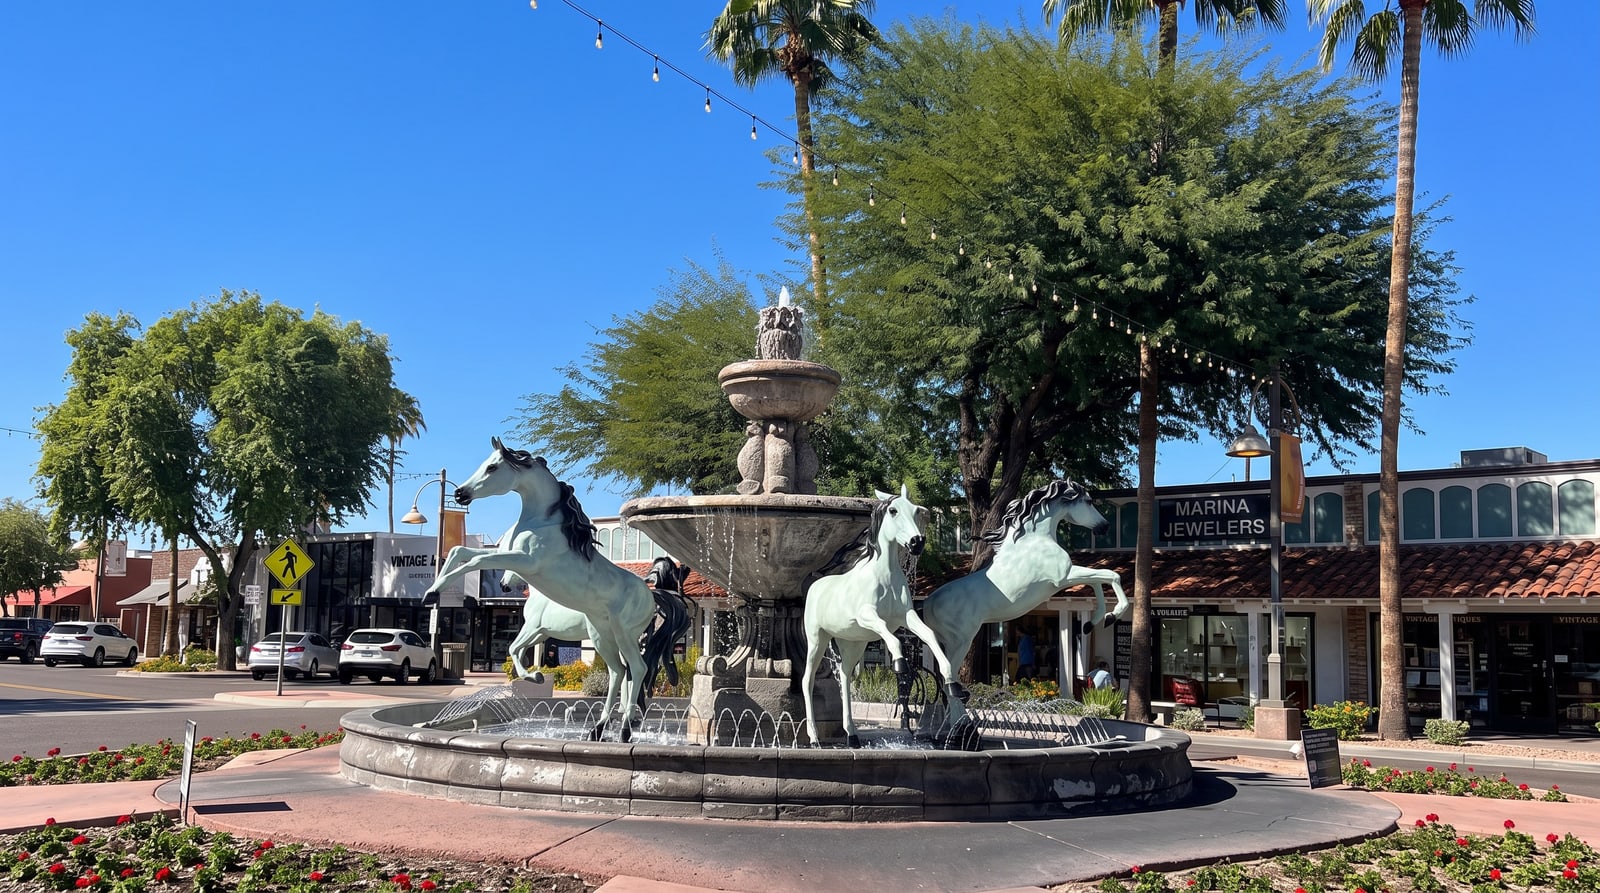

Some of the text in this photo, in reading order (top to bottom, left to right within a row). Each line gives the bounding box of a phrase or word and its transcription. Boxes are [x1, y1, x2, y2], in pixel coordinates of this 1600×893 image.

[1175, 498, 1250, 517] MARINA
[1163, 518, 1265, 538] JEWELERS
[391, 554, 428, 567] VINTAGE
[1558, 616, 1599, 624] VINTAGE
